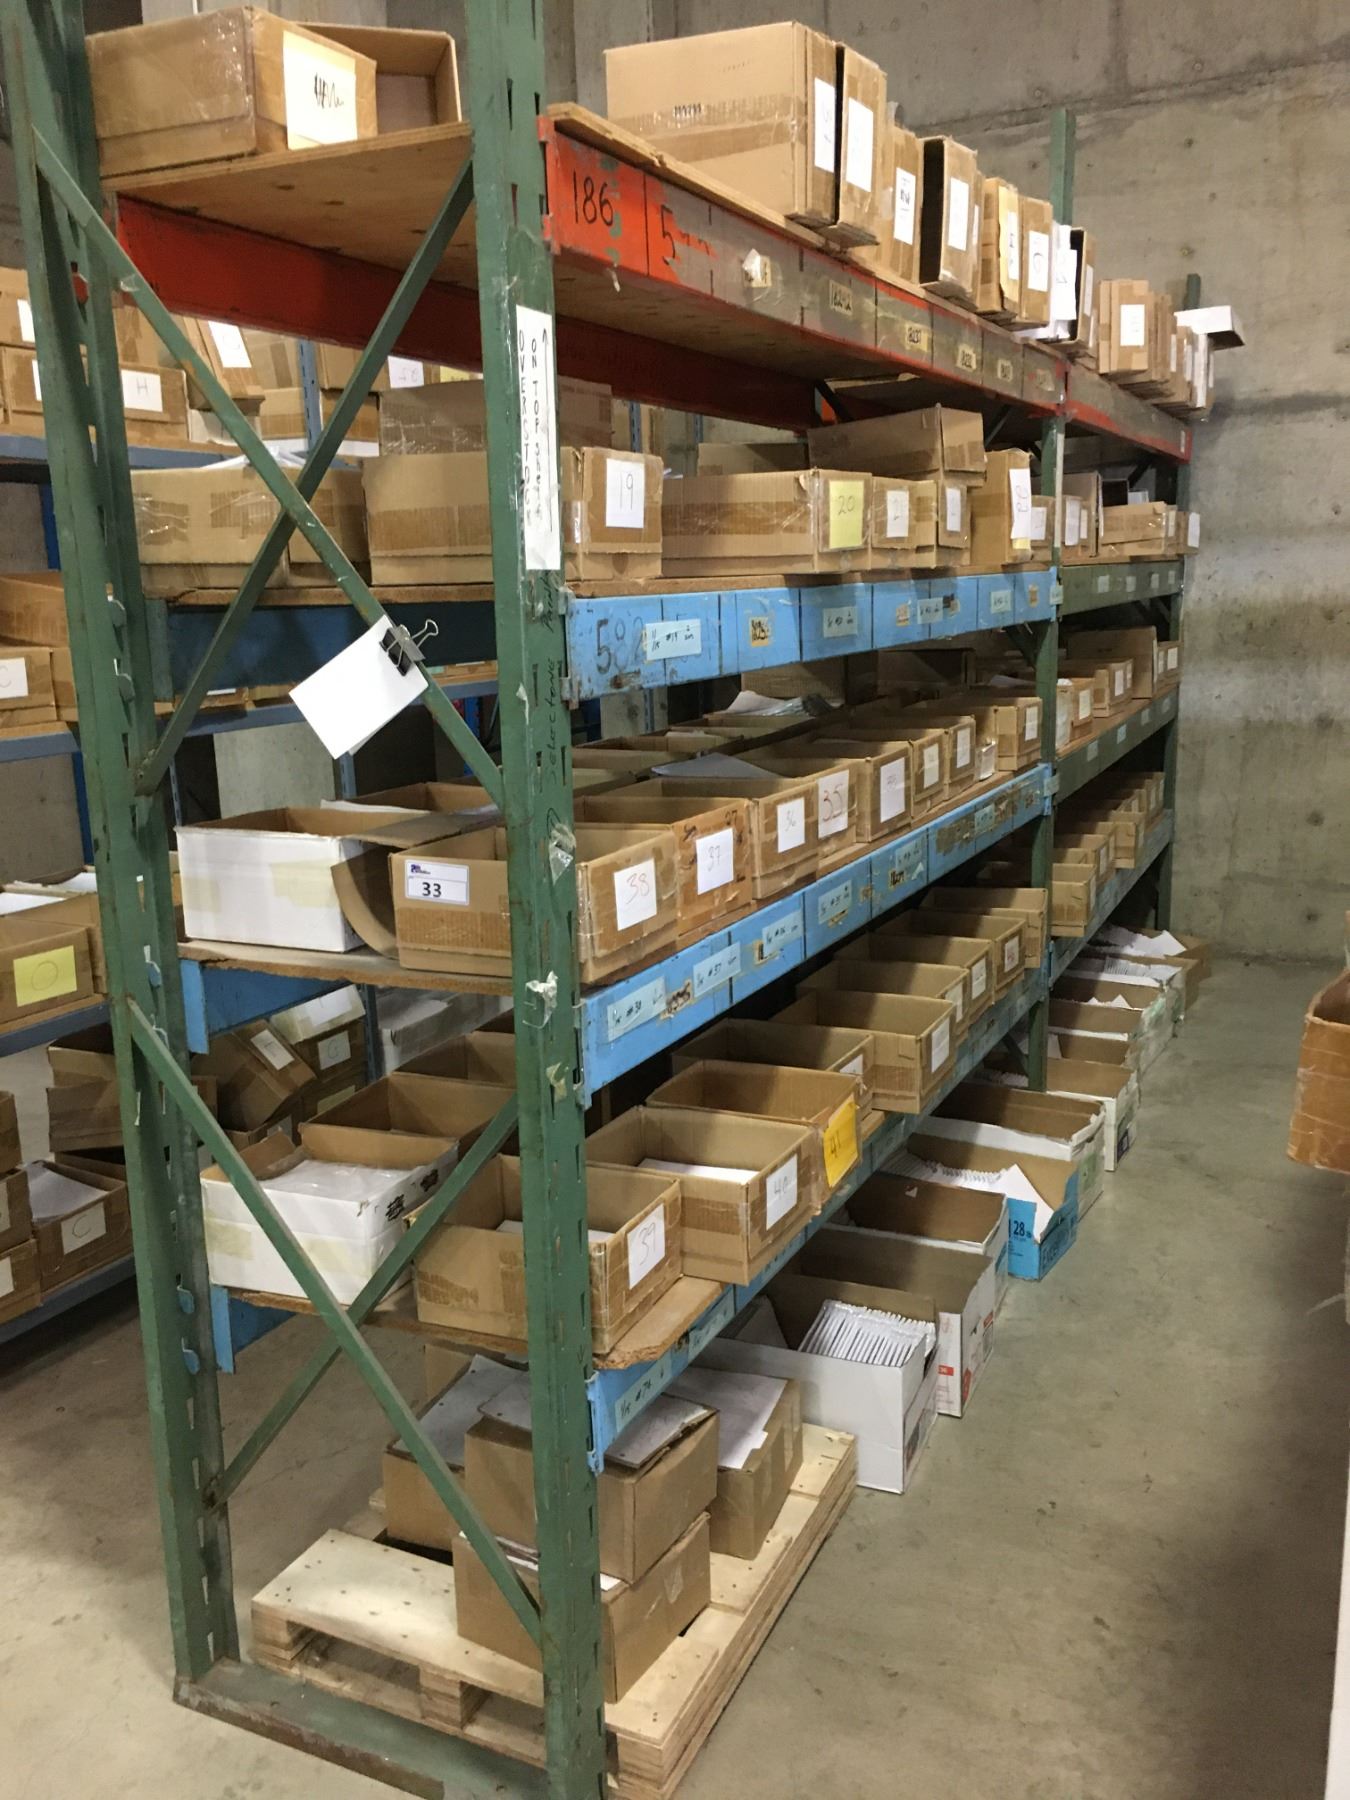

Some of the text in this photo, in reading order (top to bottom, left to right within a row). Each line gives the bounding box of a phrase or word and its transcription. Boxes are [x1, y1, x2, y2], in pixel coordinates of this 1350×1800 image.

[573, 171, 614, 226] 186
[531, 338, 538, 369] ON
[838, 495, 855, 516] 20
[822, 783, 843, 822] 35
[422, 881, 442, 898] 33
[626, 872, 650, 905] 38
[1013, 1220, 1025, 1237] 28
